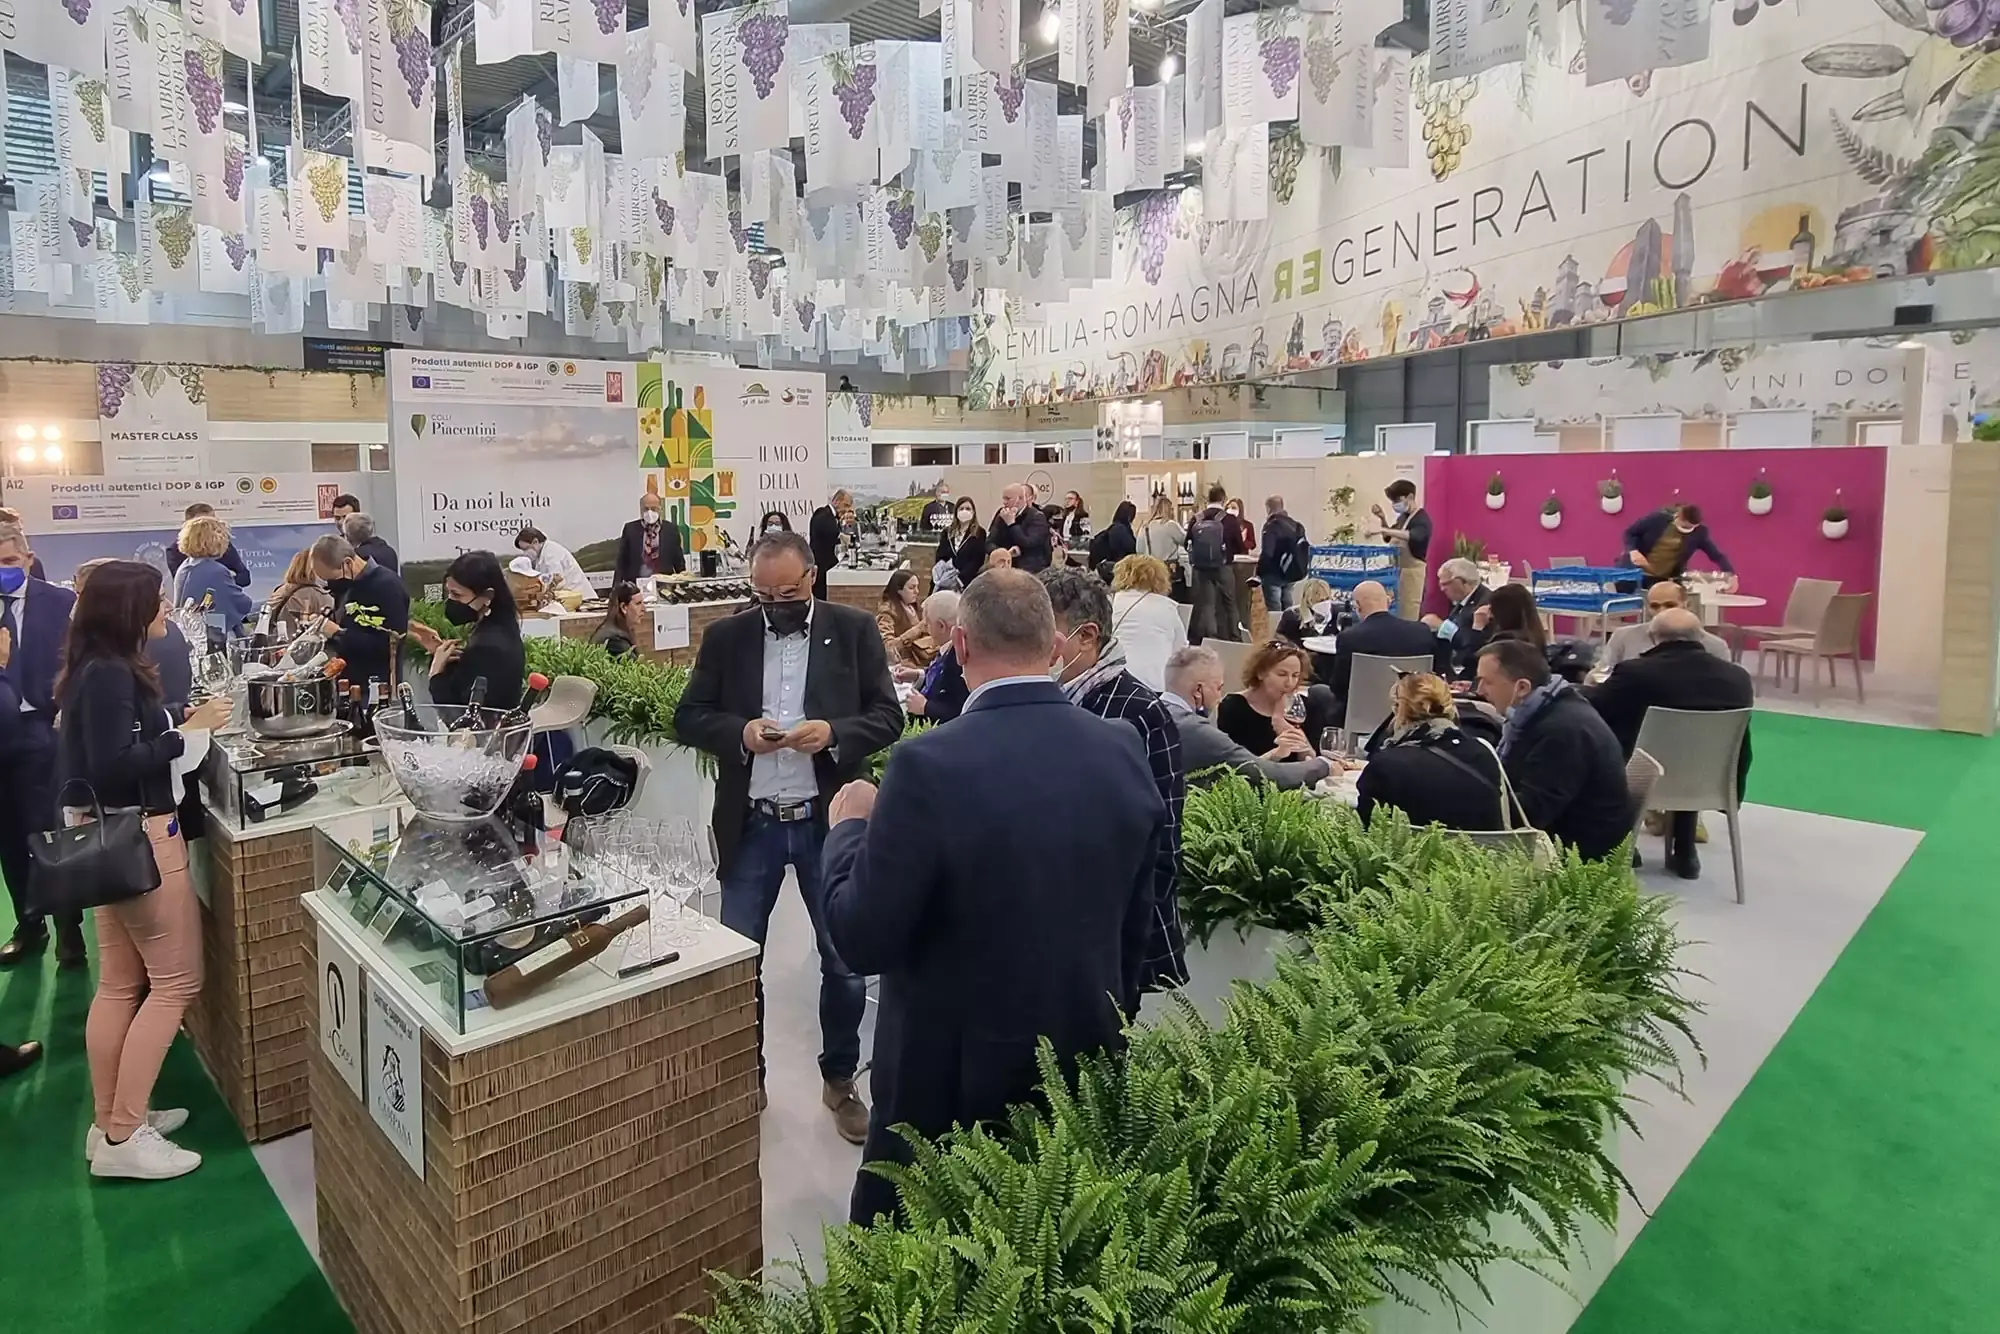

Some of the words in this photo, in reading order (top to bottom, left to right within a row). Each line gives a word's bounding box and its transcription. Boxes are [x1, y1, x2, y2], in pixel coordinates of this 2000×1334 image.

[113, 10, 132, 101] MALVASIA
[170, 31, 187, 121] SORBARA
[710, 27, 724, 126] ROMAGNA
[155, 22, 177, 150] LAMBRUSCO
[807, 71, 820, 155] FORTANA
[56, 71, 72, 161] PIGNOLETTO
[50, 182, 60, 257] LAMBRUSCO
[260, 195, 271, 251] FORTANA
[631, 167, 641, 244] LAMBRUSCO
[1006, 272, 1260, 361] EMILIA-ROMAGNA
[1332, 82, 1808, 285] GENERATION
[140, 209, 153, 285] PIGNOLETTO
[99, 256, 108, 308] ROMAGNA
[411, 357, 450, 367] Prodotti
[452, 359, 492, 369] autentici
[494, 361, 514, 370] DOP
[524, 363, 539, 371] IGP
[1725, 372, 1803, 391] VINI
[111, 432, 159, 441] MASTER
[161, 431, 199, 441] CLASS
[431, 421, 497, 436] Piacentini
[759, 445, 768, 462] IL
[774, 445, 808, 462] MITO
[6, 480, 23, 490] A12
[51, 483, 104, 493] Prodotti
[108, 481, 161, 491] autentici
[165, 481, 191, 490] DOP
[195, 480, 202, 490] &
[205, 480, 225, 490] IGP
[432, 492, 459, 511] Da
[466, 491, 493, 510] noi
[500, 491, 514, 509] la
[521, 491, 551, 508] vita
[759, 473, 800, 489] DELLA
[432, 515, 447, 534] si
[454, 513, 533, 536] sorseggia
